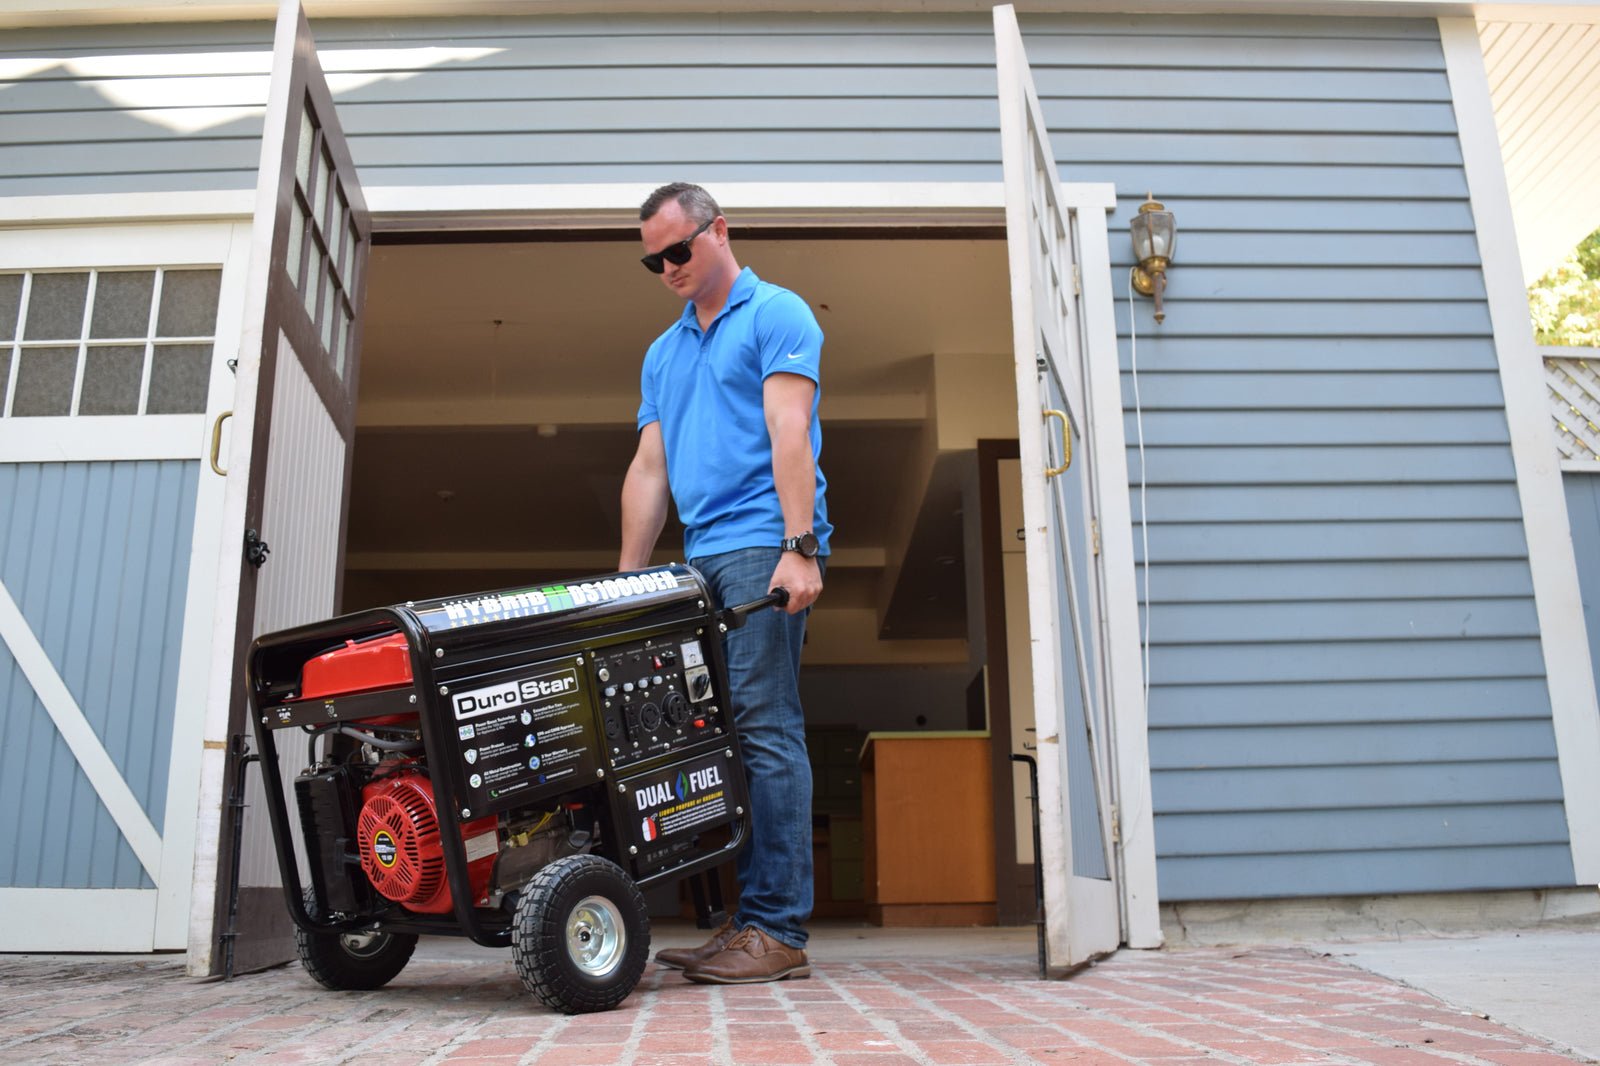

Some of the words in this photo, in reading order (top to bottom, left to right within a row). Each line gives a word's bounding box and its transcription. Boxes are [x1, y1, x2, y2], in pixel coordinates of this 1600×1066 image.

[444, 591, 546, 620] HYBRID
[636, 781, 675, 810] DUAL
[689, 766, 723, 792] FUEL
